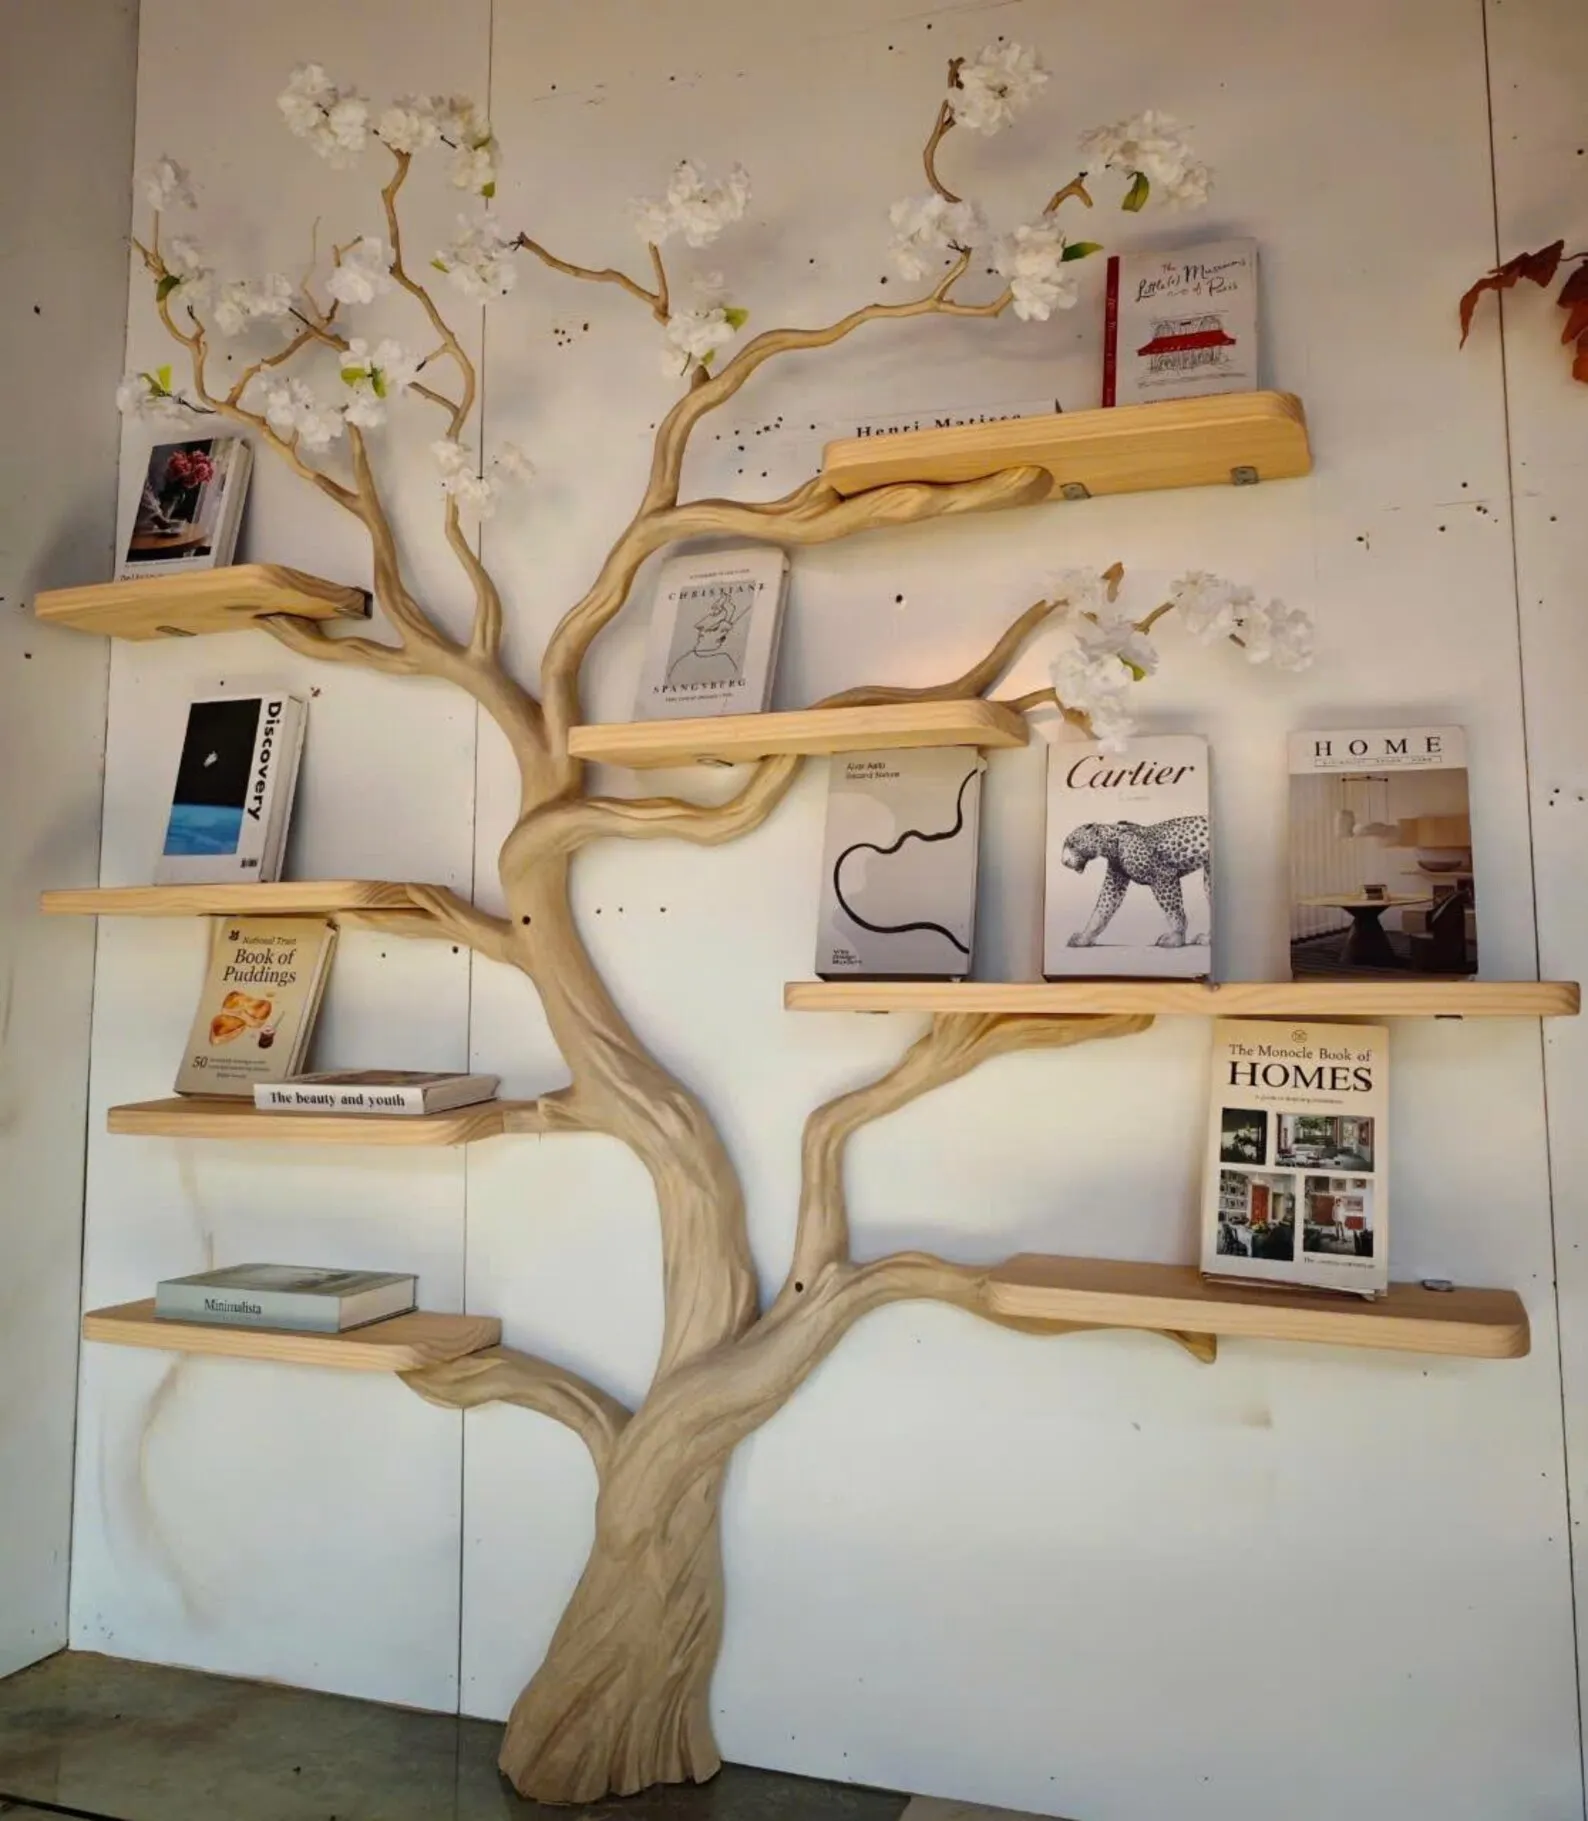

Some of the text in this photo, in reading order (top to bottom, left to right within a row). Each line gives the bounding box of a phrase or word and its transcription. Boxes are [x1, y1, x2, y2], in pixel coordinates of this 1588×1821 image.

[1314, 735, 1442, 757] HOME
[247, 701, 283, 822] Discovery
[1066, 755, 1196, 789] Cartier
[235, 947, 297, 966] Book of
[223, 965, 297, 987] Puddings
[192, 1055, 208, 1069] 50
[1229, 1043, 1372, 1062] The Monocle Book of
[1228, 1060, 1374, 1092] HOMES
[269, 1091, 406, 1109] The beauty and youth
[204, 1298, 262, 1314] Minimalista
